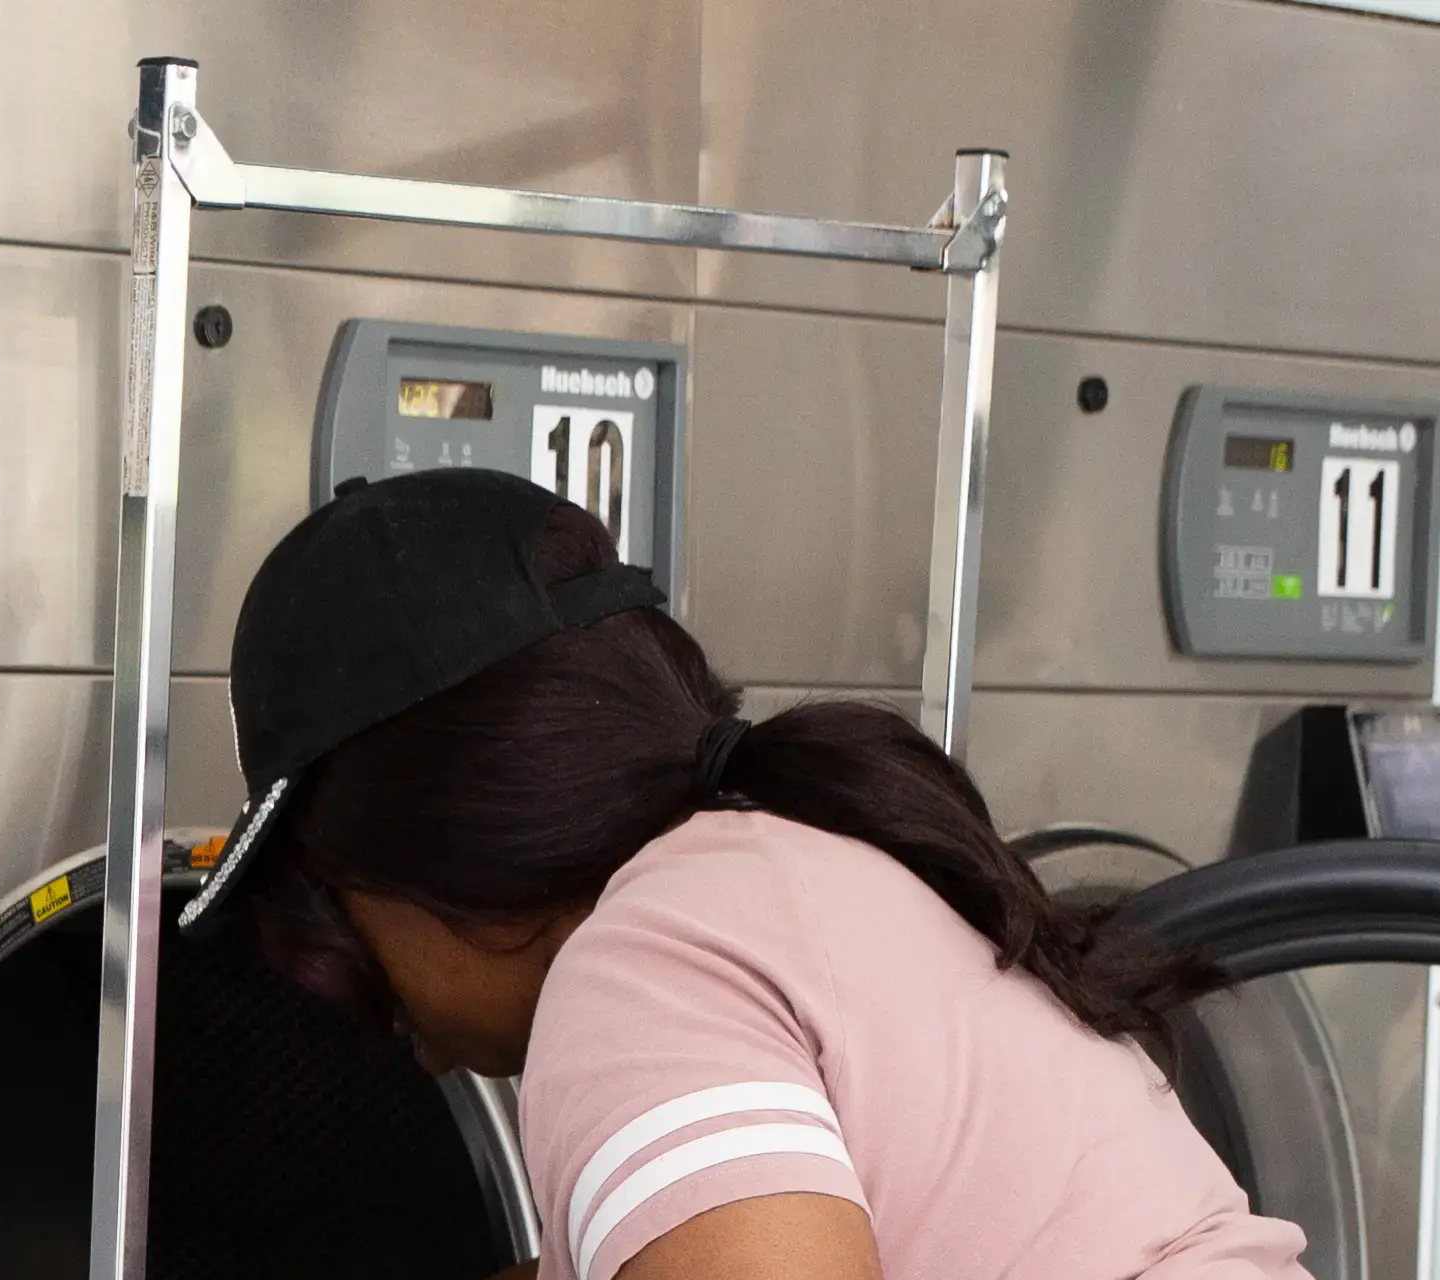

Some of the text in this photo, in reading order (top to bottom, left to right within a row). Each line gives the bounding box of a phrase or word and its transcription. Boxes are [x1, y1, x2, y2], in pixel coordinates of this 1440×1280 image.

[541, 365, 631, 398] Huebsch
[548, 416, 624, 540] 10
[1334, 468, 1385, 589] 11
[37, 895, 70, 918] CAUTION
